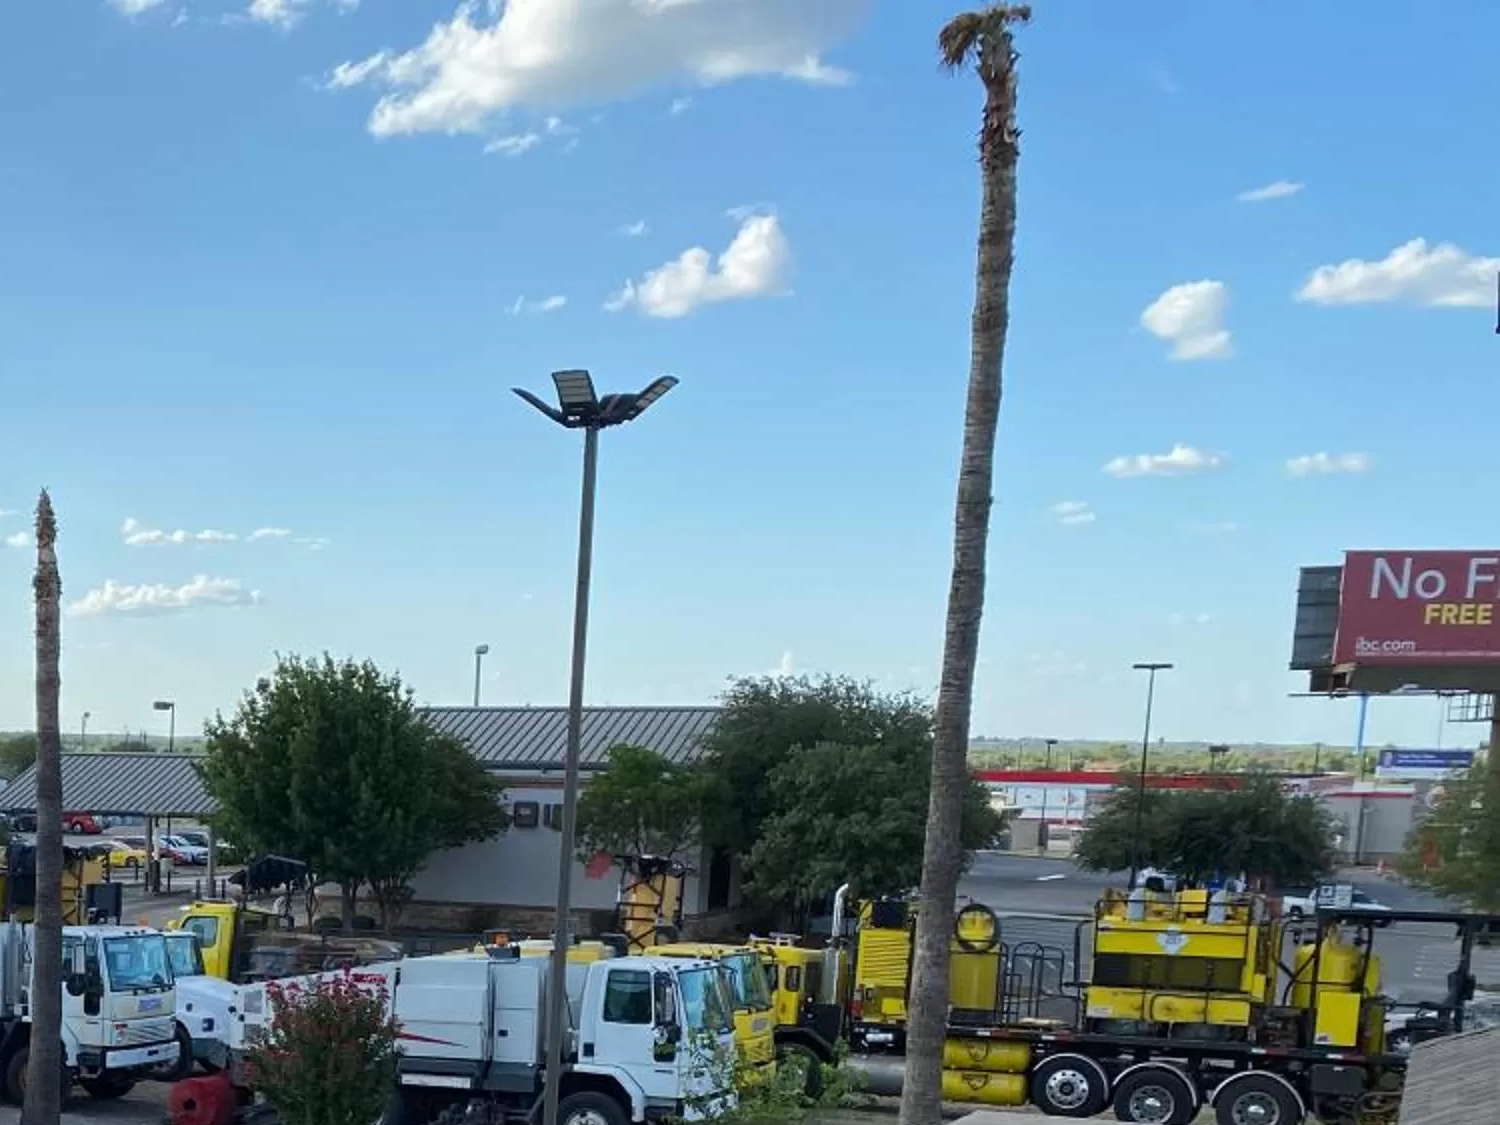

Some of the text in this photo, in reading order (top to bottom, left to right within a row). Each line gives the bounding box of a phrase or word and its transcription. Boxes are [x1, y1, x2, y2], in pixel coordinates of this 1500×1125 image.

[1370, 557, 1500, 599] No F
[1424, 603, 1493, 625] FREE
